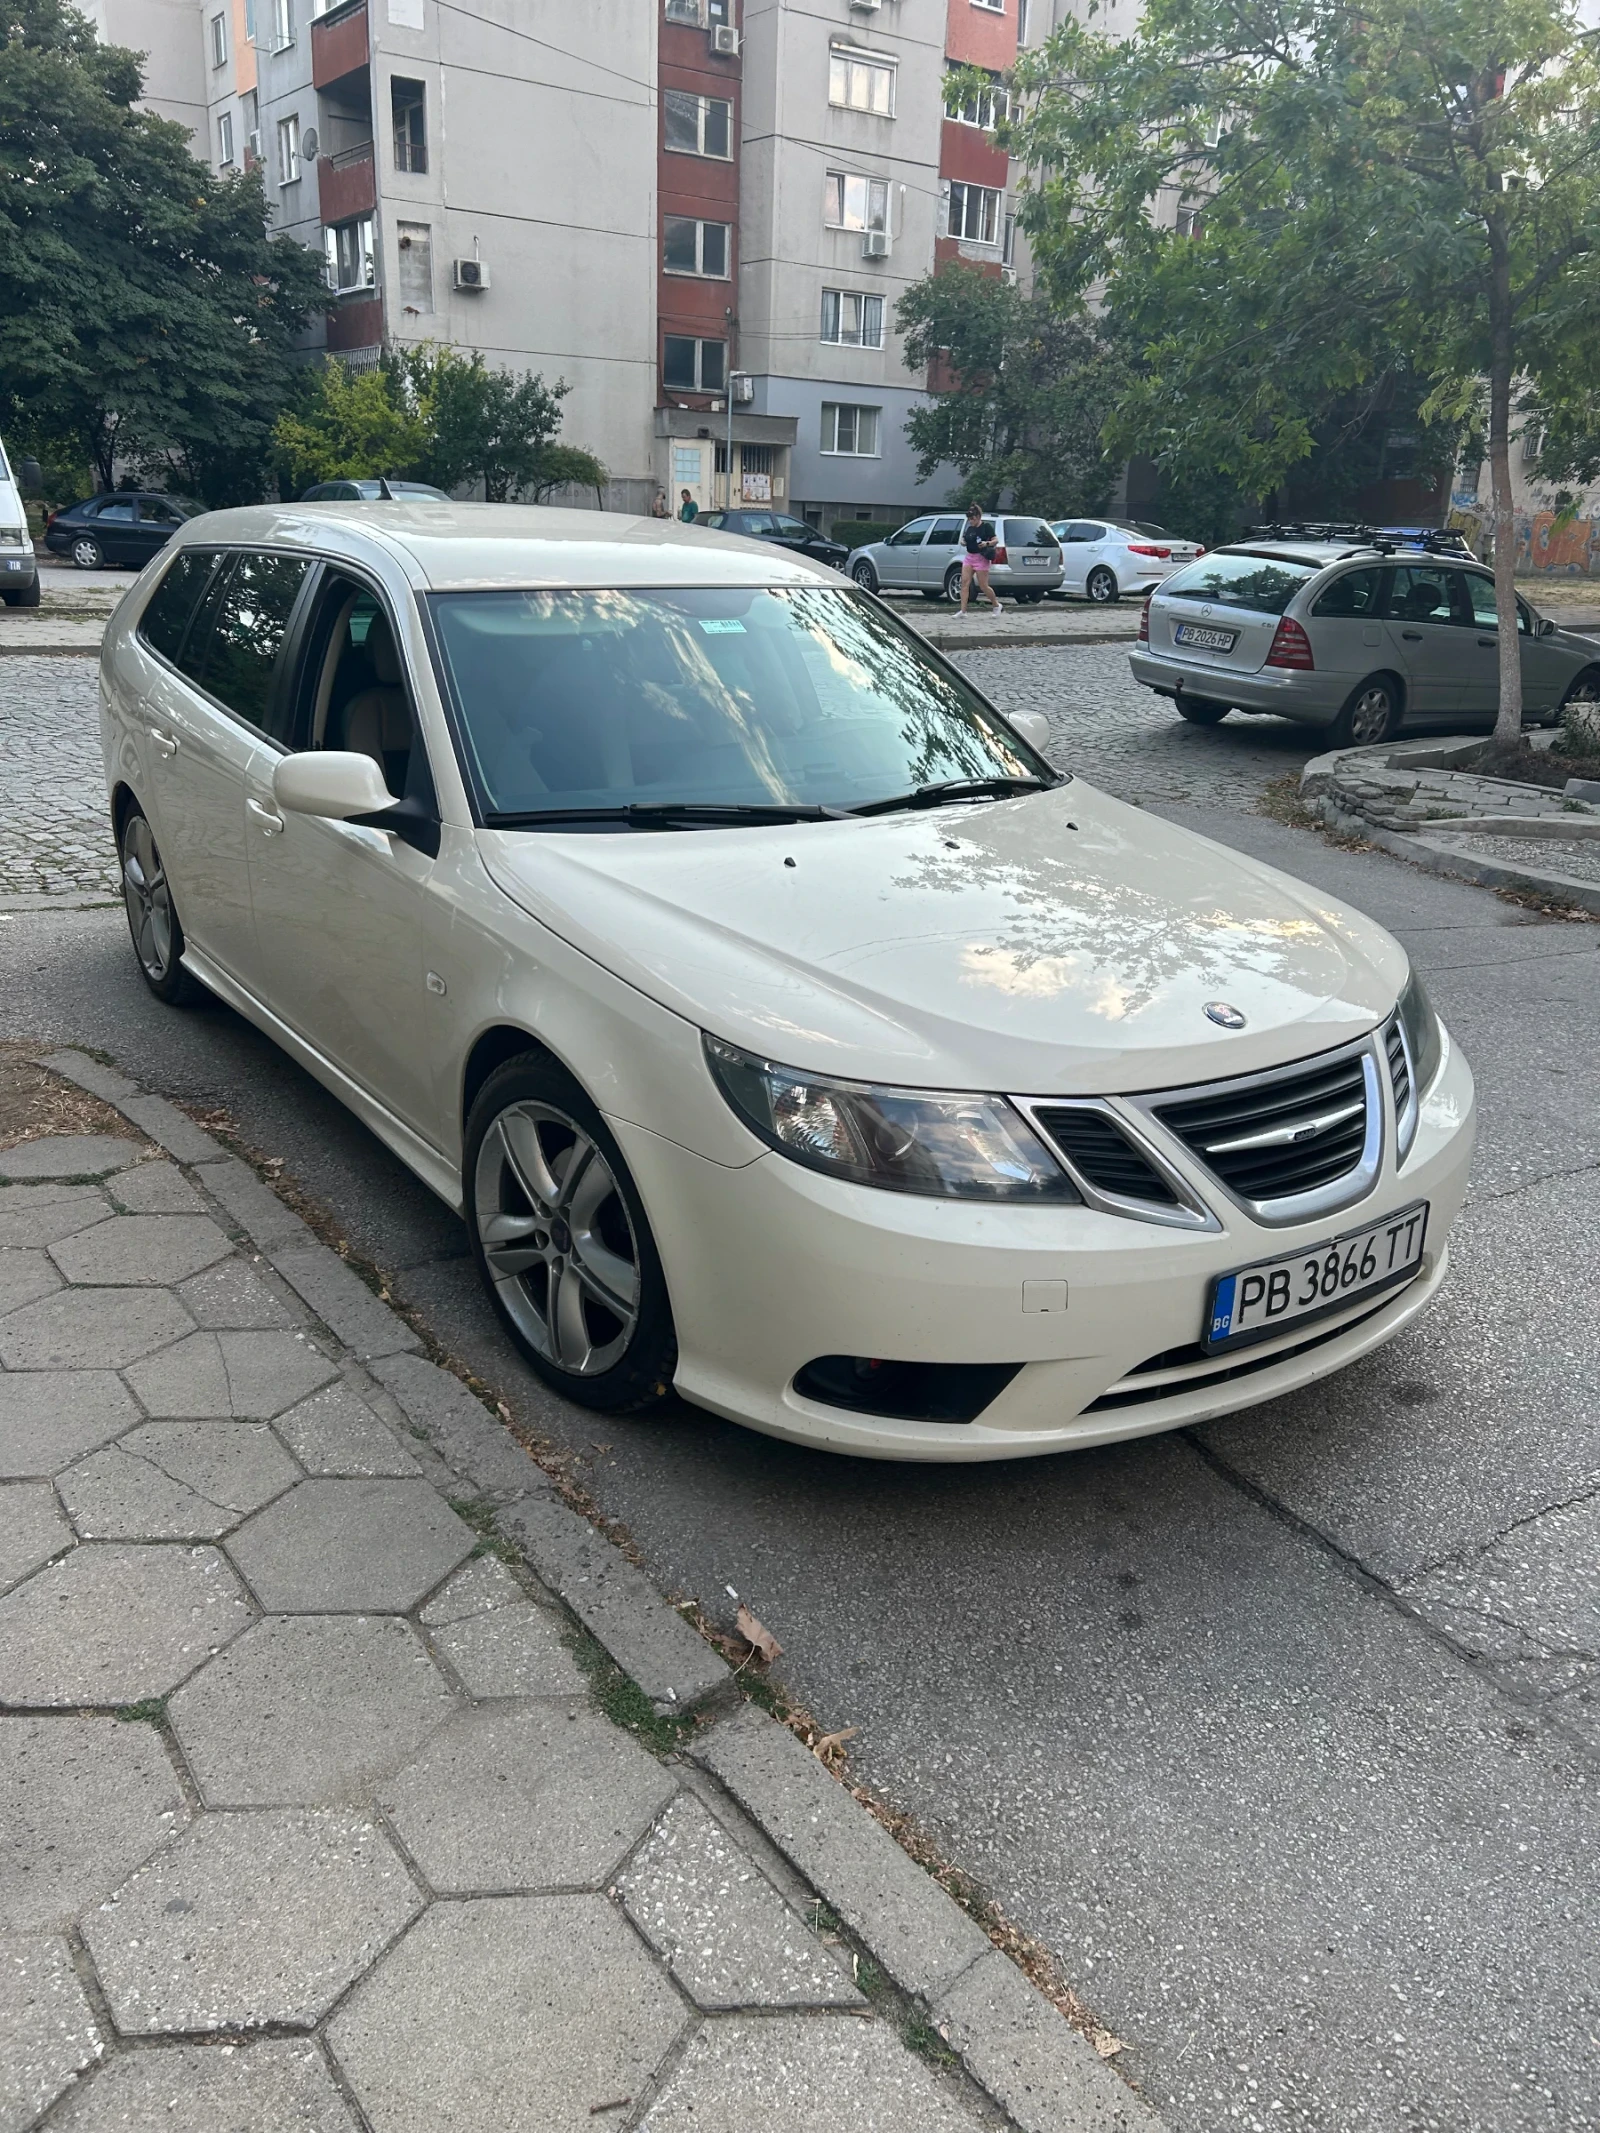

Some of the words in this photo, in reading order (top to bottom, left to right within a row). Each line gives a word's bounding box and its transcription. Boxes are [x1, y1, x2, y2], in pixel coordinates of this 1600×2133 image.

[1182, 627, 1195, 640] PB
[1195, 630, 1217, 644] 2026
[1217, 633, 1232, 647] HP
[1238, 1269, 1291, 1324] PB
[1298, 1235, 1378, 1306] 3866
[1387, 1213, 1421, 1269] TT
[1212, 1314, 1230, 1332] BG
